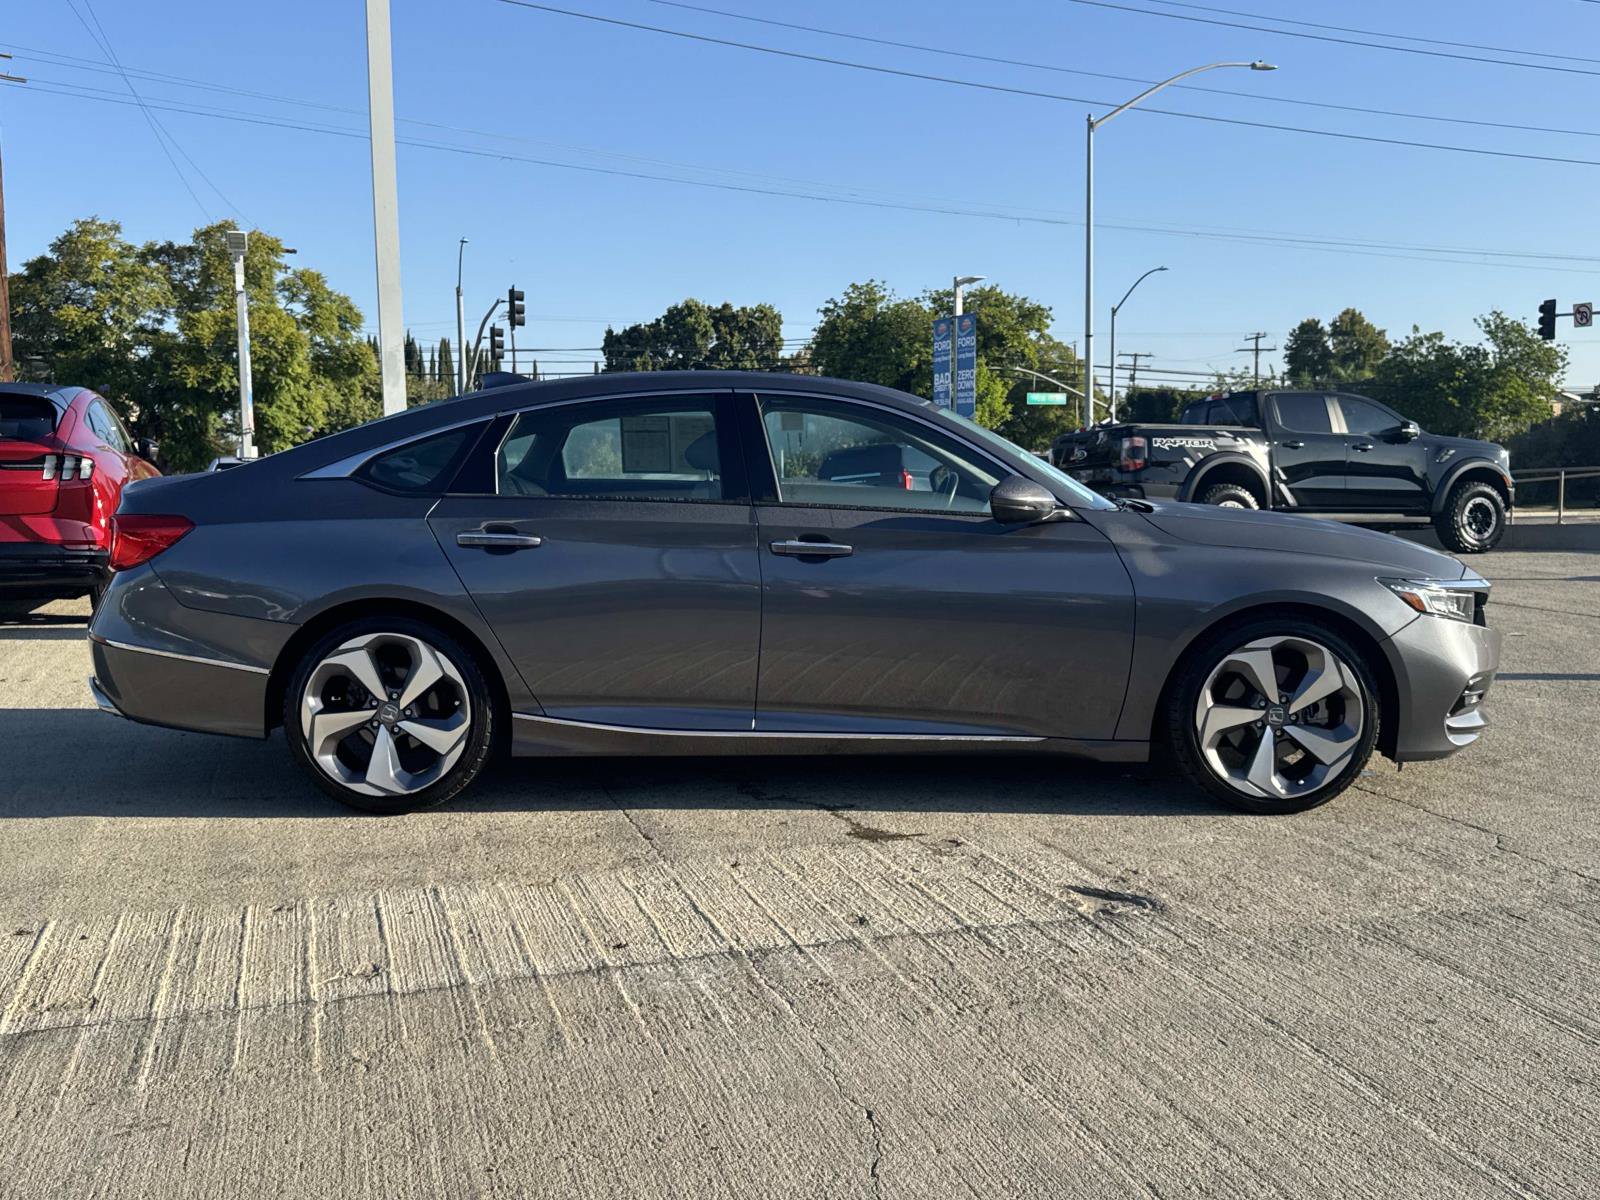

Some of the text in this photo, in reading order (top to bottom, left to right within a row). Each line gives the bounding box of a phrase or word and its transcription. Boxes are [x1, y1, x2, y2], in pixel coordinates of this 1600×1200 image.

[934, 340, 951, 351] FORD
[958, 336, 975, 348] FORD
[934, 372, 951, 386] BAD
[958, 369, 974, 380] ZERO
[958, 380, 974, 390] DOWN
[1152, 437, 1218, 451] RAPTOR
